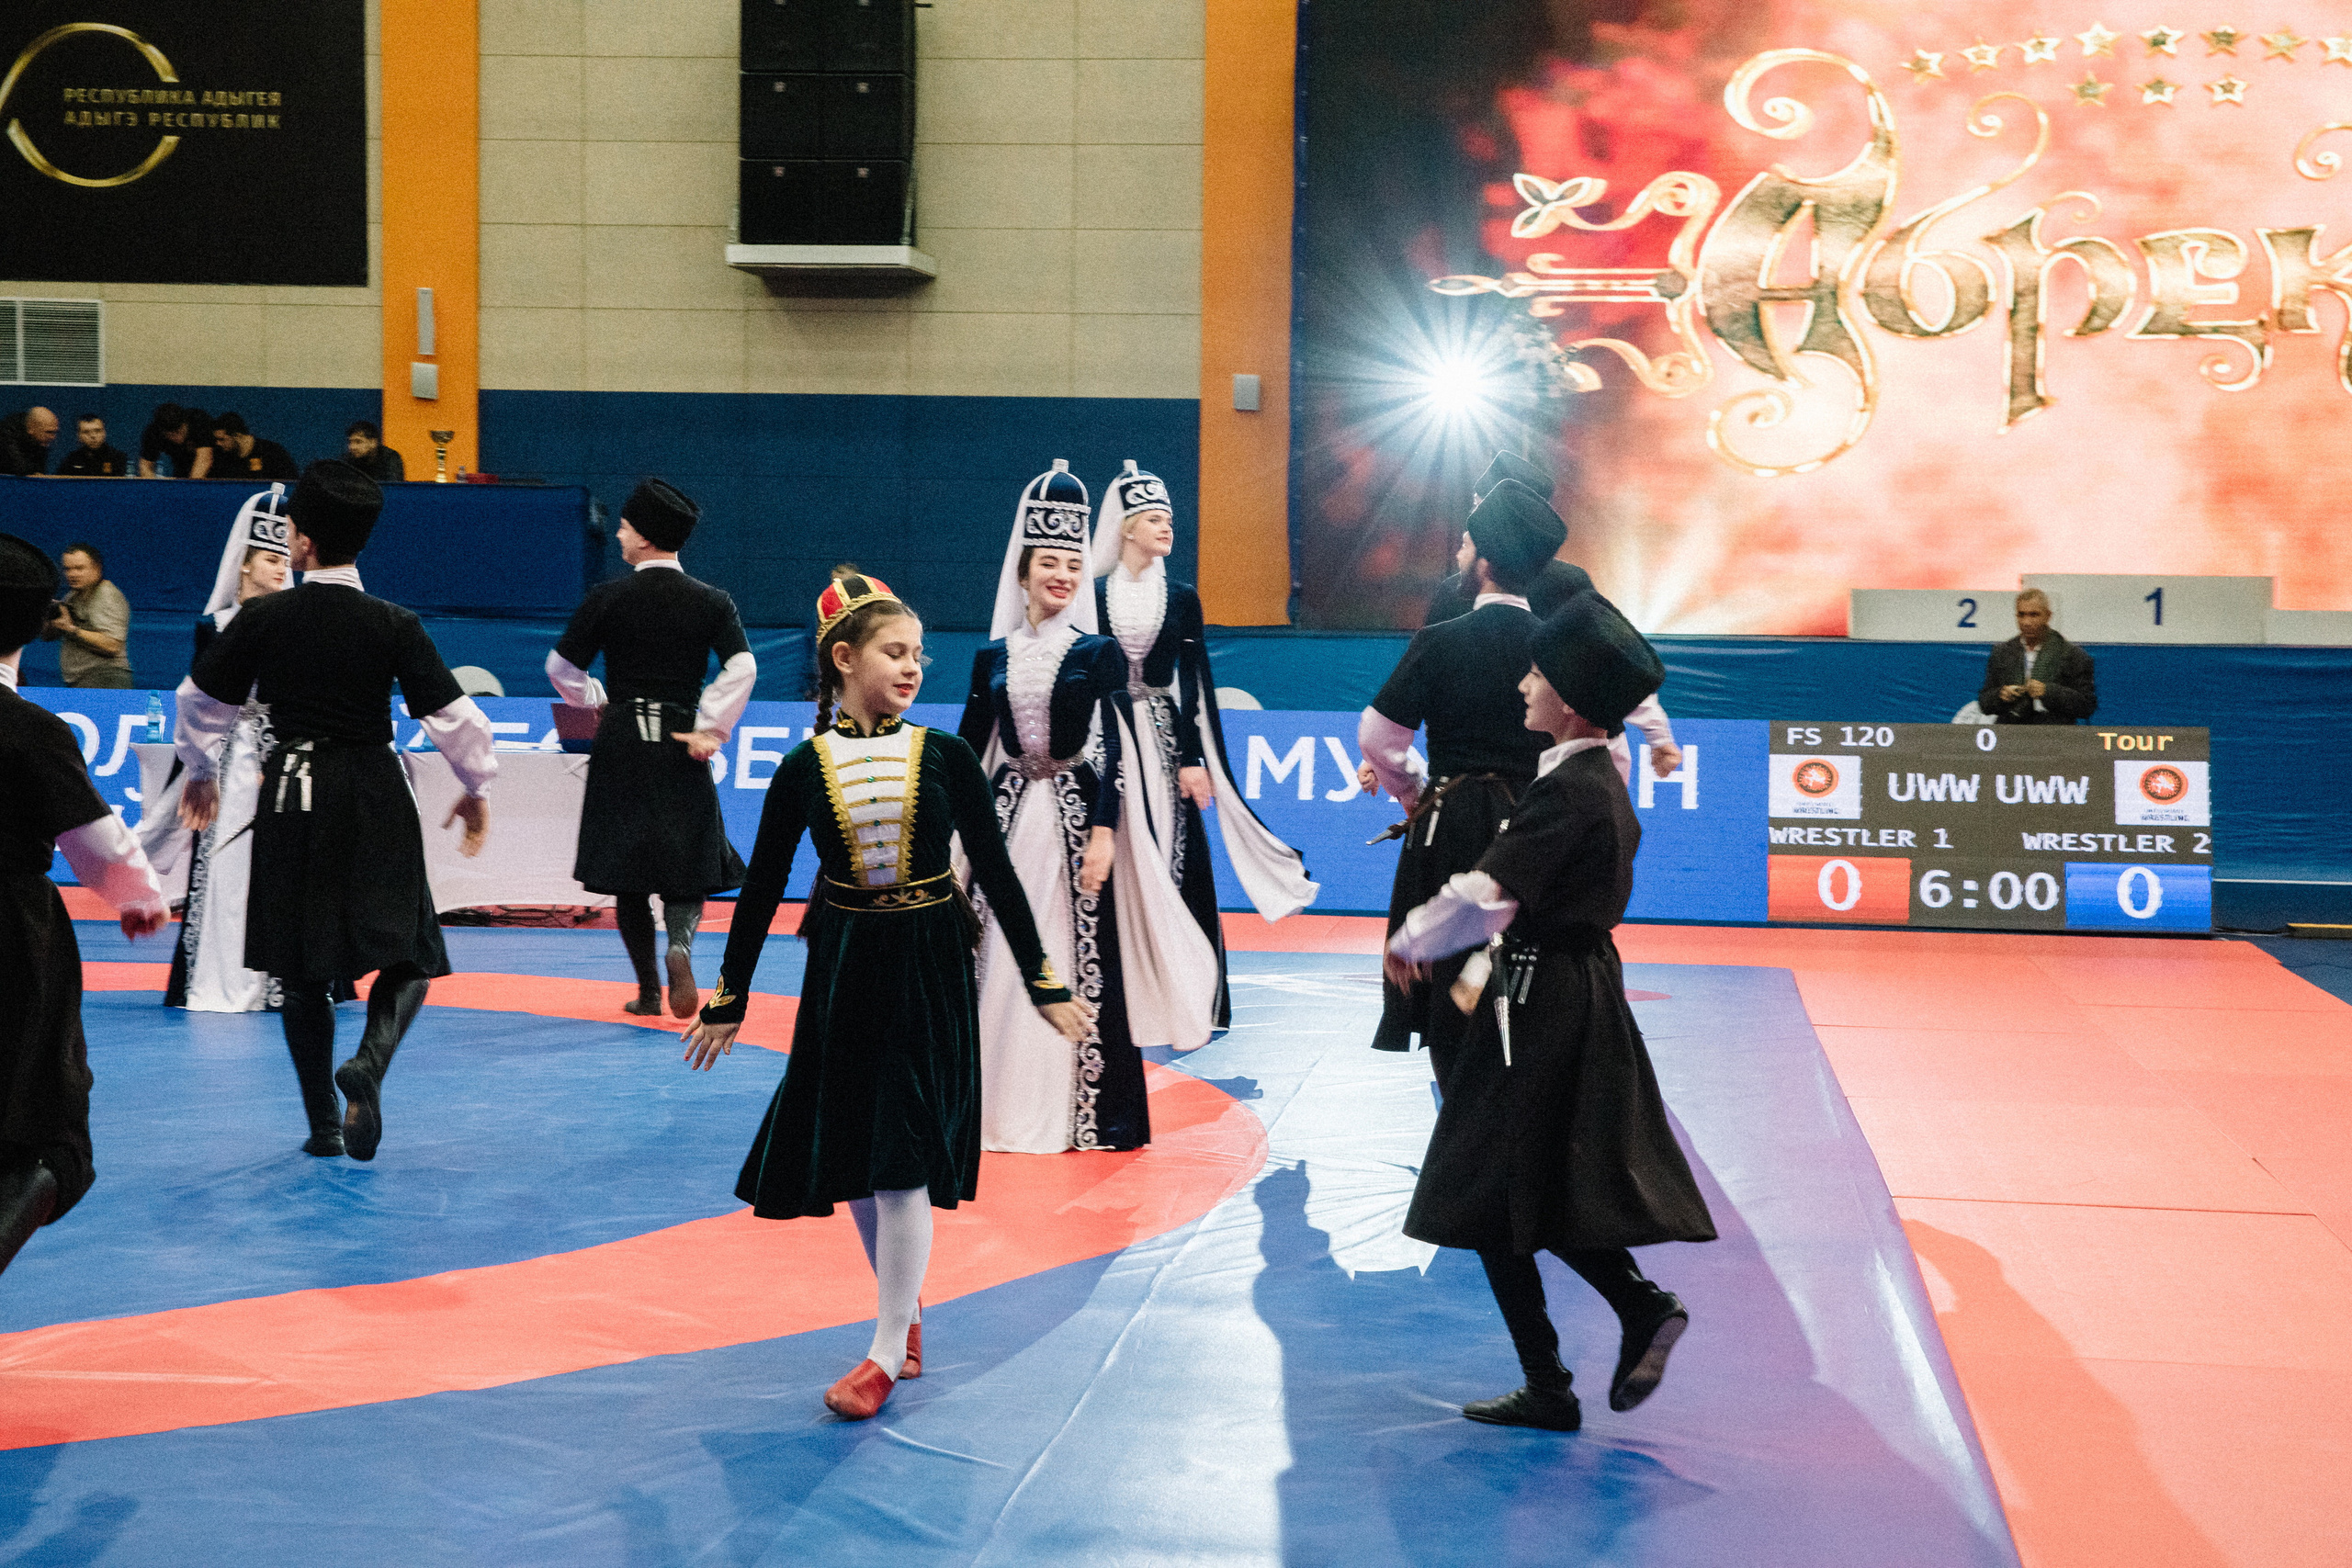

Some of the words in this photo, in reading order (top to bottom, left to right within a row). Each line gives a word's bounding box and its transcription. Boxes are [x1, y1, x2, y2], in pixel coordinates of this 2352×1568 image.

[63, 87, 196, 105] РЕСПУБЛИКА
[200, 90, 282, 107] АДЫГЕЯ
[63, 110, 139, 128] АДЫГЭ
[148, 111, 281, 129] РЕСПУБЛИК
[1957, 597, 1979, 628] 2
[2144, 586, 2165, 626] 1
[1786, 726, 1823, 746] FS
[1839, 725, 1894, 749] 120
[1975, 728, 1997, 751] 0
[2097, 731, 2175, 751] Tour
[1887, 772, 1981, 803] UWW
[1996, 773, 2090, 806] UWW
[1768, 826, 1917, 848] WRESTLER
[1933, 828, 1954, 849] 1
[2021, 831, 2177, 854] WRESTLER
[2192, 832, 2211, 854] 2
[1817, 859, 1862, 911] 0
[1918, 869, 2060, 911] 6:00
[2116, 865, 2164, 919] 0
